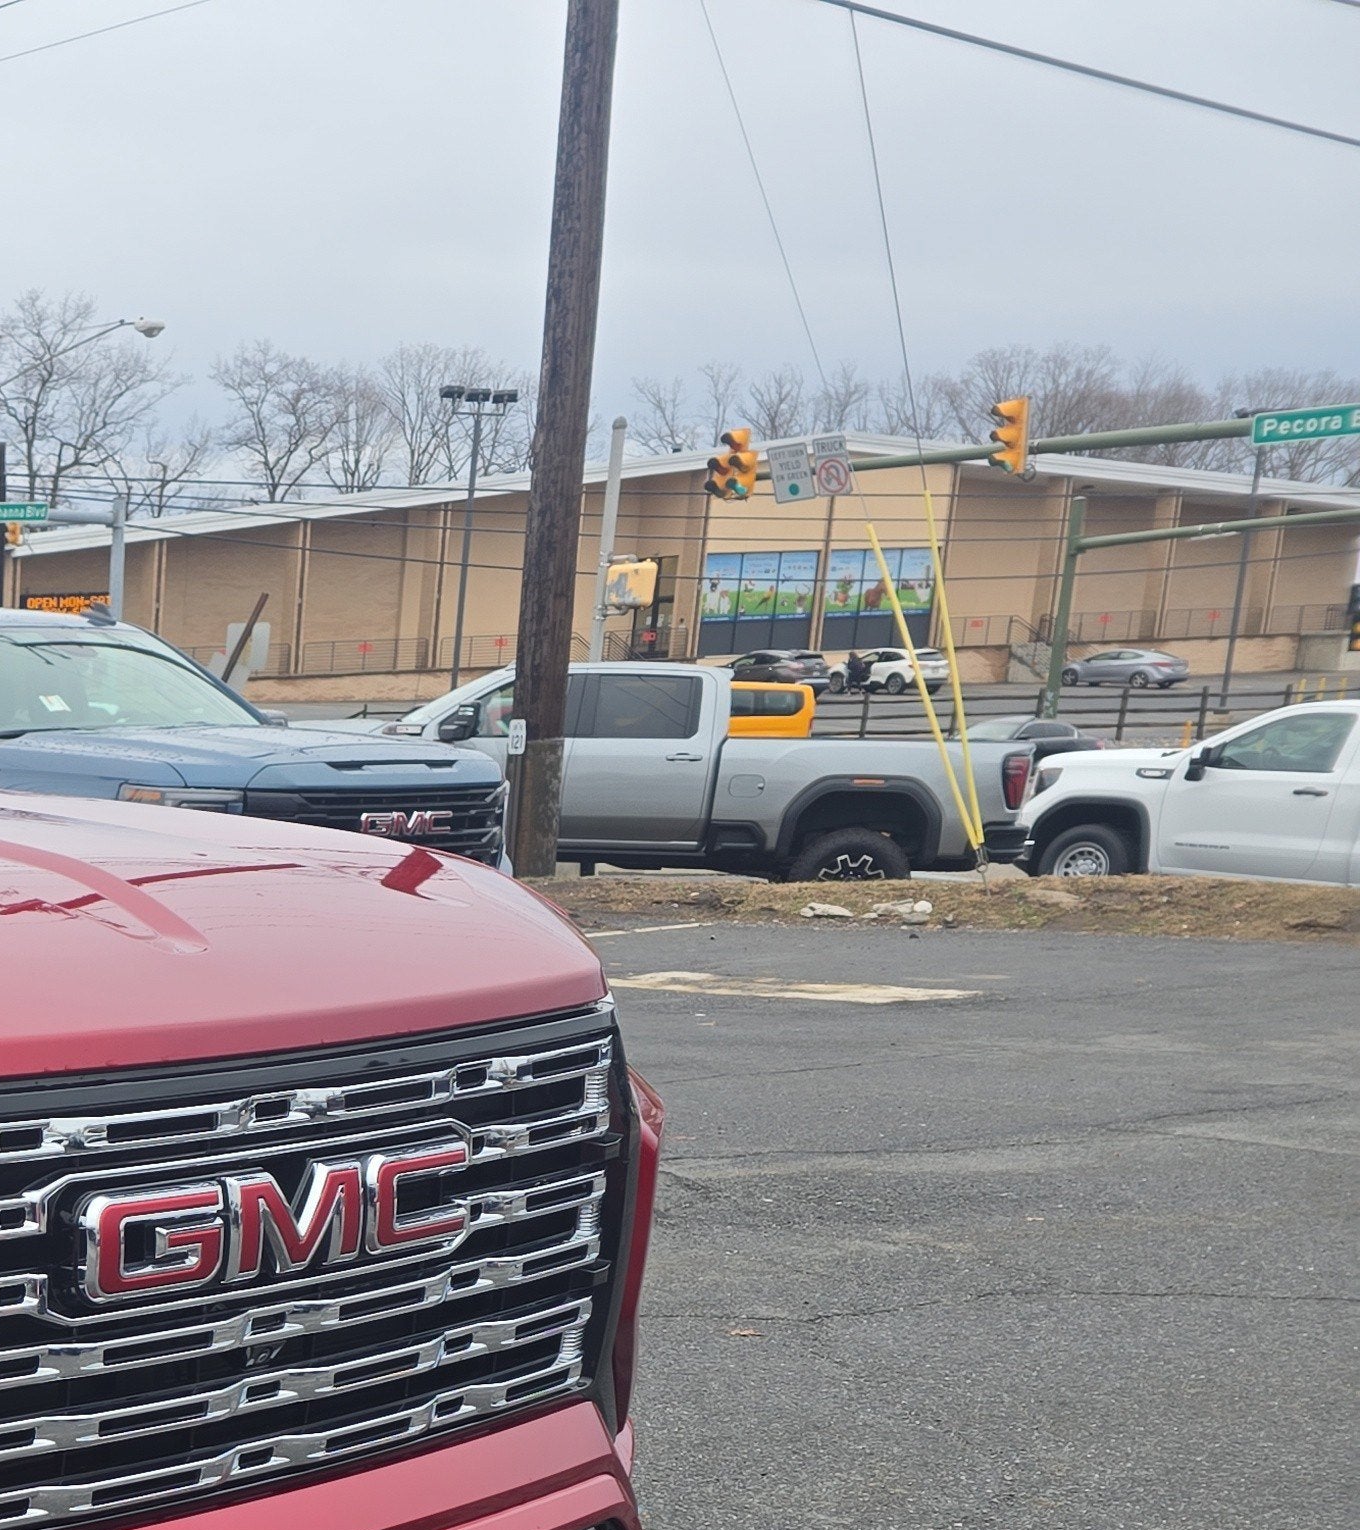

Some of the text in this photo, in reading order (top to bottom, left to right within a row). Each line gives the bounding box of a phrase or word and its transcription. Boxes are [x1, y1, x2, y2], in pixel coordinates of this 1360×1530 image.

[1263, 415, 1342, 437] Pecora
[816, 440, 843, 453] TRUCK
[779, 460, 801, 471] YIELD
[26, 505, 46, 517] Blvd
[26, 597, 58, 609] OPEN
[361, 810, 454, 836] GMC
[84, 1141, 470, 1302] GMC
